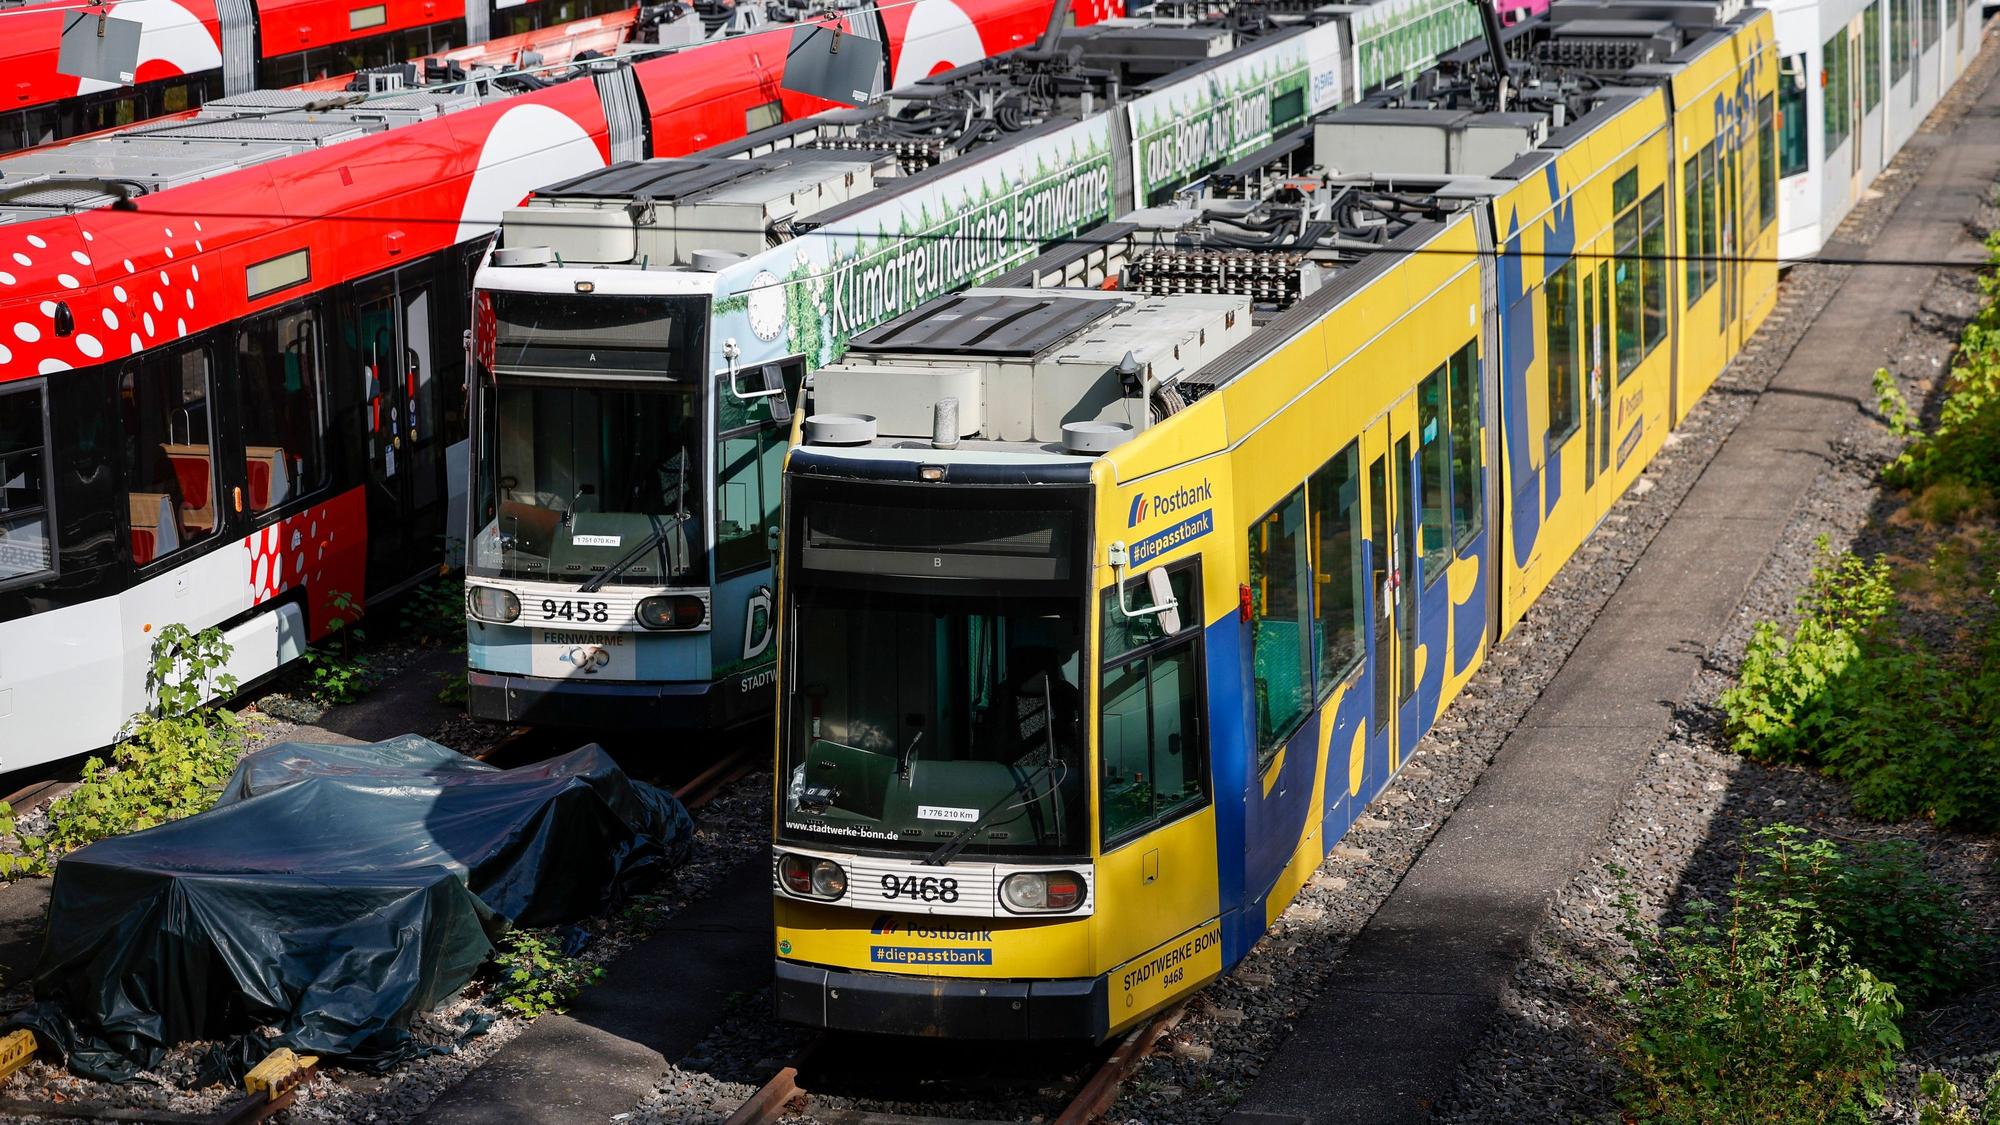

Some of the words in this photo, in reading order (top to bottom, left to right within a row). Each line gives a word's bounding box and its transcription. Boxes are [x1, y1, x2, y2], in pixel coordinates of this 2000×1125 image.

[1147, 134, 1172, 185] aus
[1233, 80, 1270, 144] Bonn!
[832, 198, 1008, 338] Klimafreundliche
[1013, 163, 1108, 250] Fernwärme
[590, 353, 597, 361] A
[1154, 477, 1212, 517] Postbank
[1133, 513, 1209, 562] #diepasstbank
[934, 557, 942, 567] B
[541, 599, 609, 623] 9458
[929, 809, 943, 817] 776
[944, 810, 959, 818] 210
[960, 811, 973, 819] Km
[785, 821, 899, 841] www.stadtwerke-bonn.de
[880, 873, 960, 903] 9468
[907, 920, 993, 942] Postbank
[876, 948, 986, 964] #diepasstbank
[1123, 942, 1192, 991] STADTWERKE
[1194, 927, 1222, 955] BONN
[1163, 967, 1184, 989] 9468
